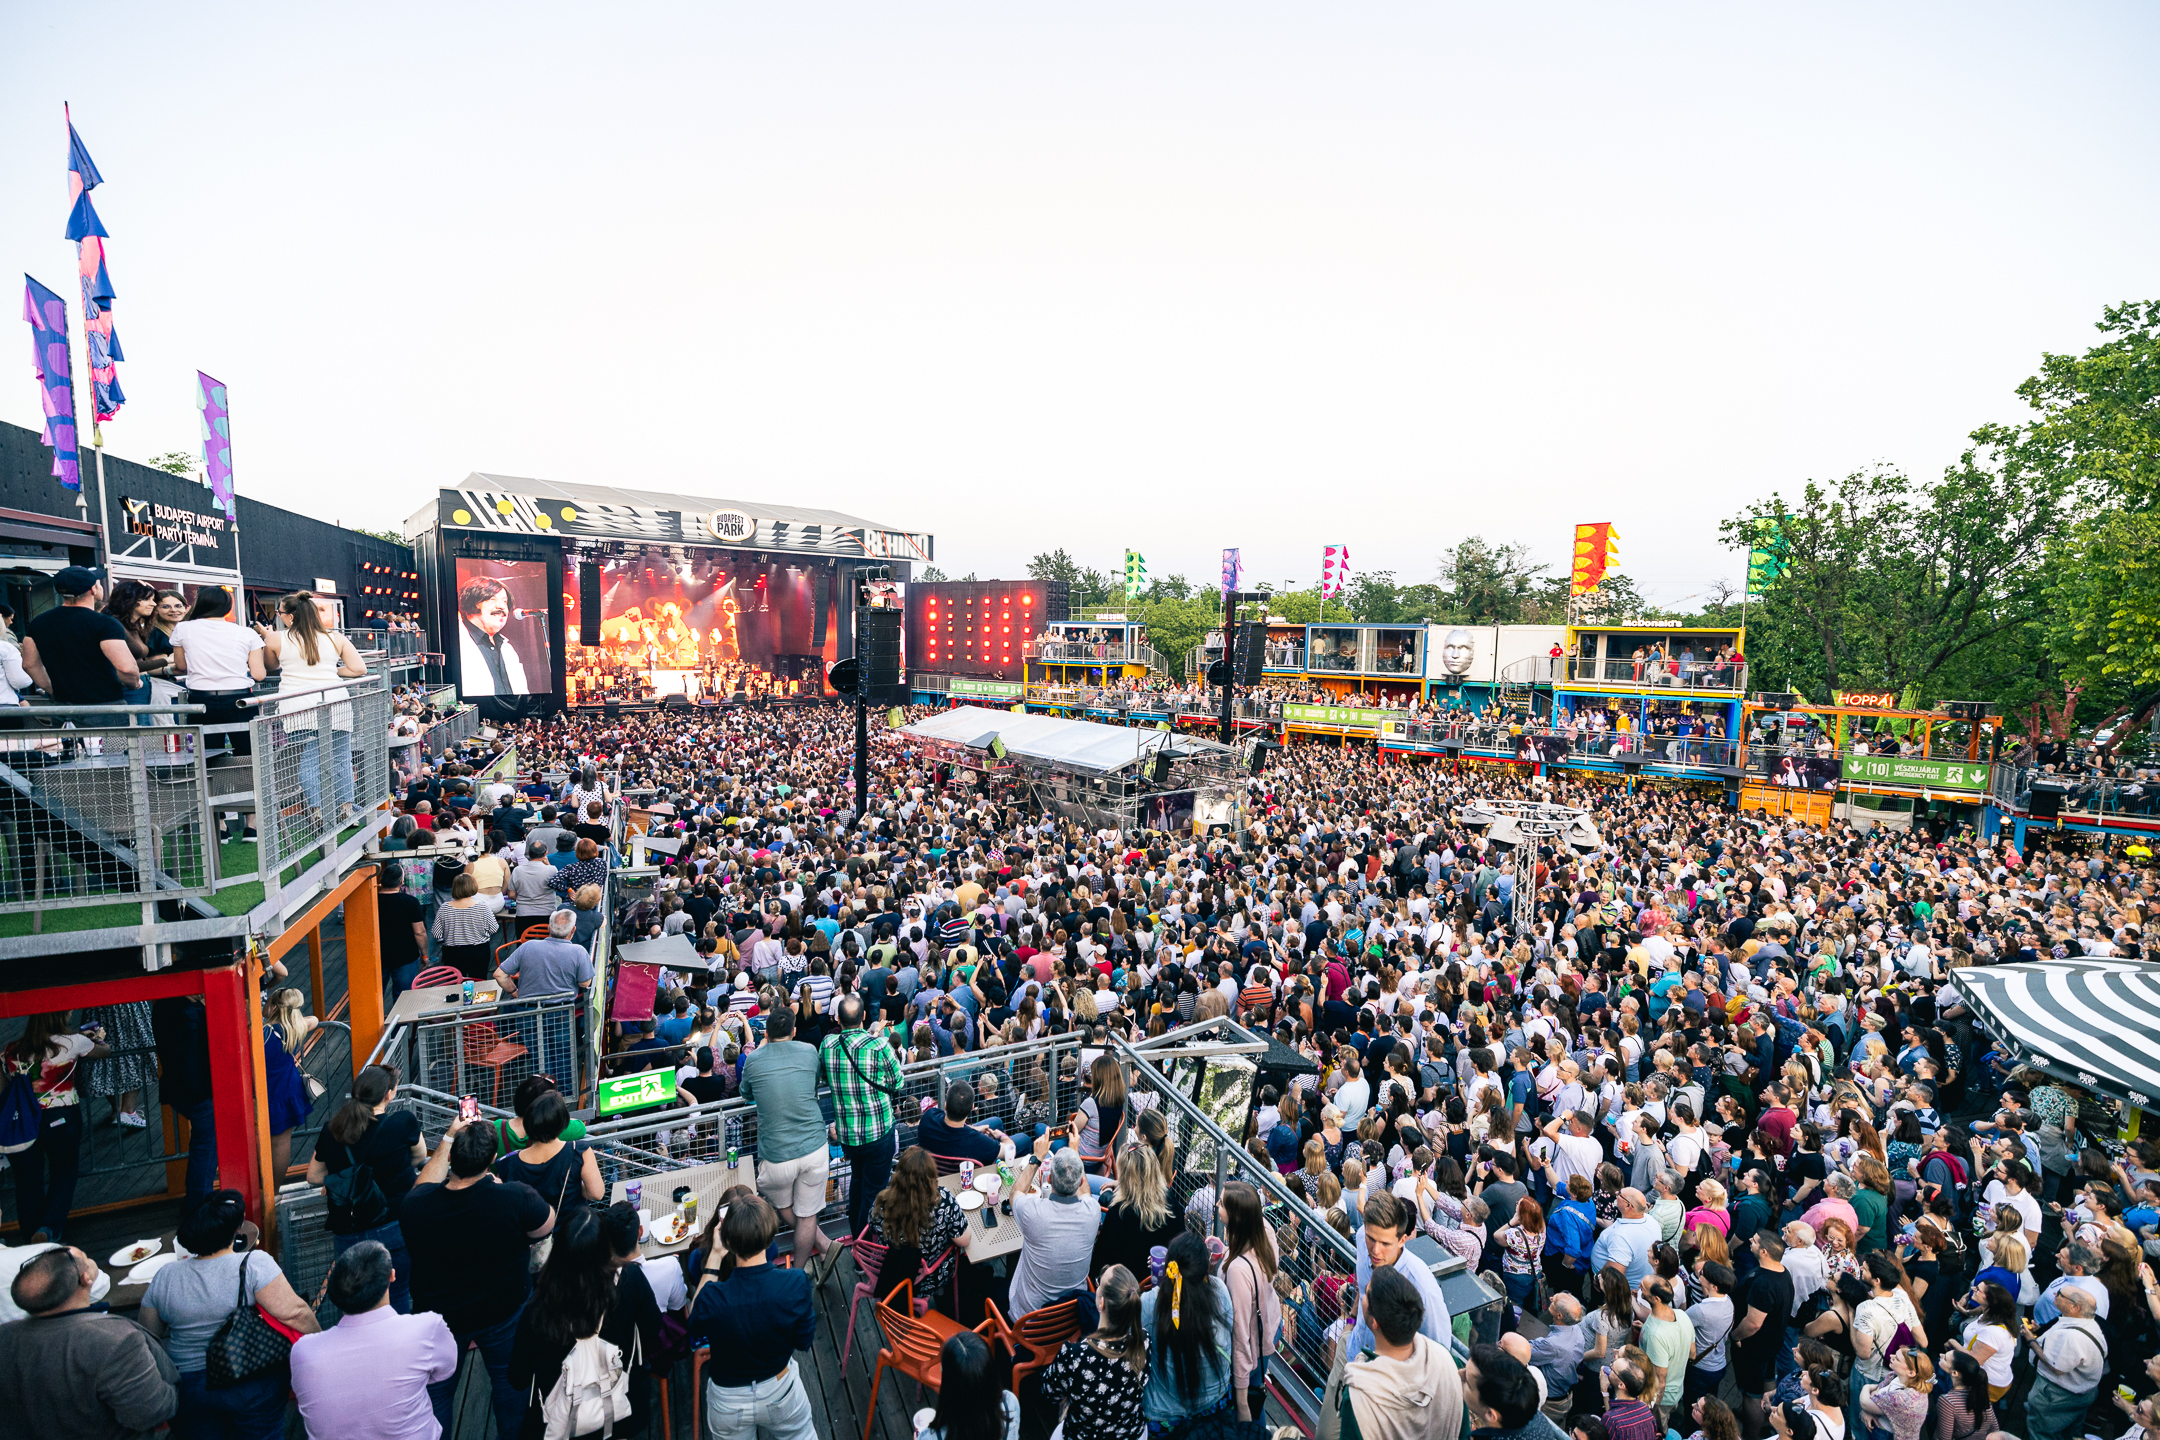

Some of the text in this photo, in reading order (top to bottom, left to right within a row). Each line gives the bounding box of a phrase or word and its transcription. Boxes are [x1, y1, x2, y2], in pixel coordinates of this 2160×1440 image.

[154, 503, 225, 532] BUDAPEST AIRPORT
[717, 513, 744, 524] BUDAPEST
[132, 517, 154, 537] bud
[717, 522, 744, 536] PARK
[156, 524, 219, 549] PARTY TERMINAL
[864, 529, 928, 561] BEHIND
[1621, 619, 1683, 628] McDonald's
[1866, 761, 1941, 777] [10] VÉSZKIJÁRAT
[1893, 770, 1927, 779] EMERGENCY
[609, 1091, 642, 1107] EXIT
